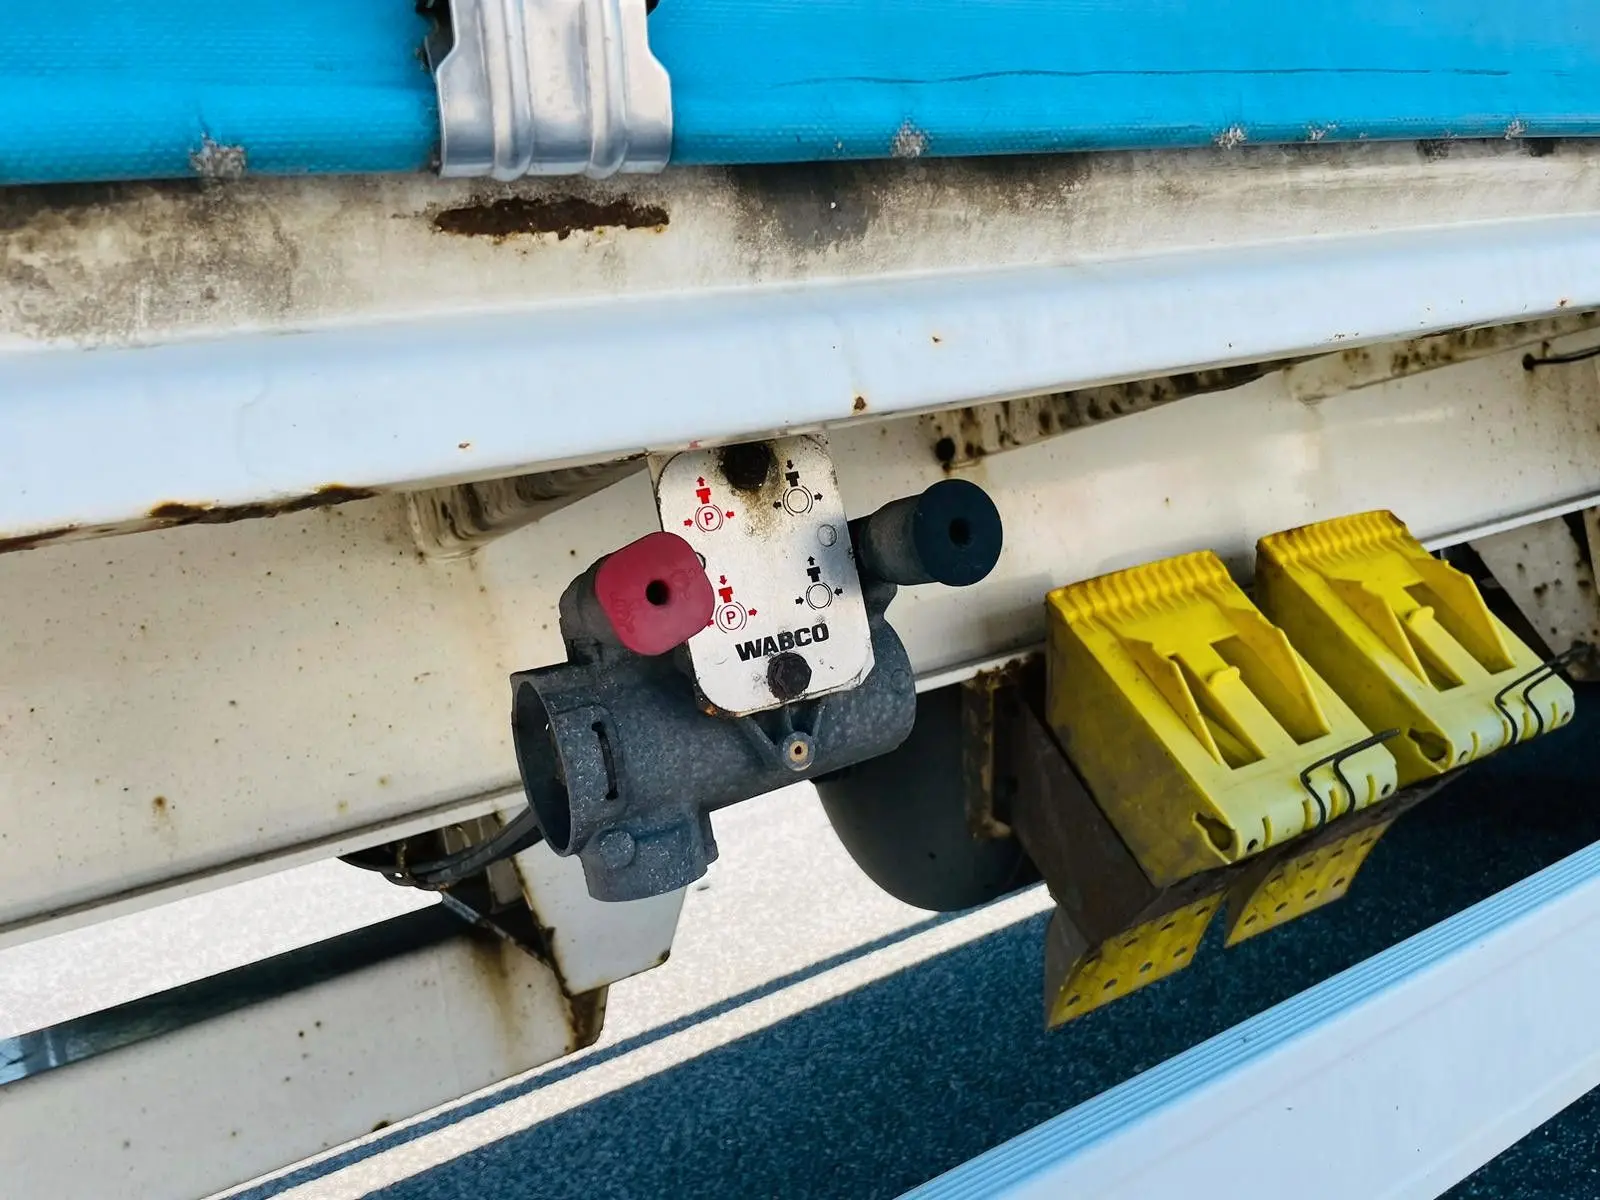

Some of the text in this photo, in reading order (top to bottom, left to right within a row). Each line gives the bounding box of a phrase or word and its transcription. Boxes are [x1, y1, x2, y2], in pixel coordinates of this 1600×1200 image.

[704, 512, 714, 525] P
[726, 611, 736, 624] P
[735, 623, 829, 662] WABCO
